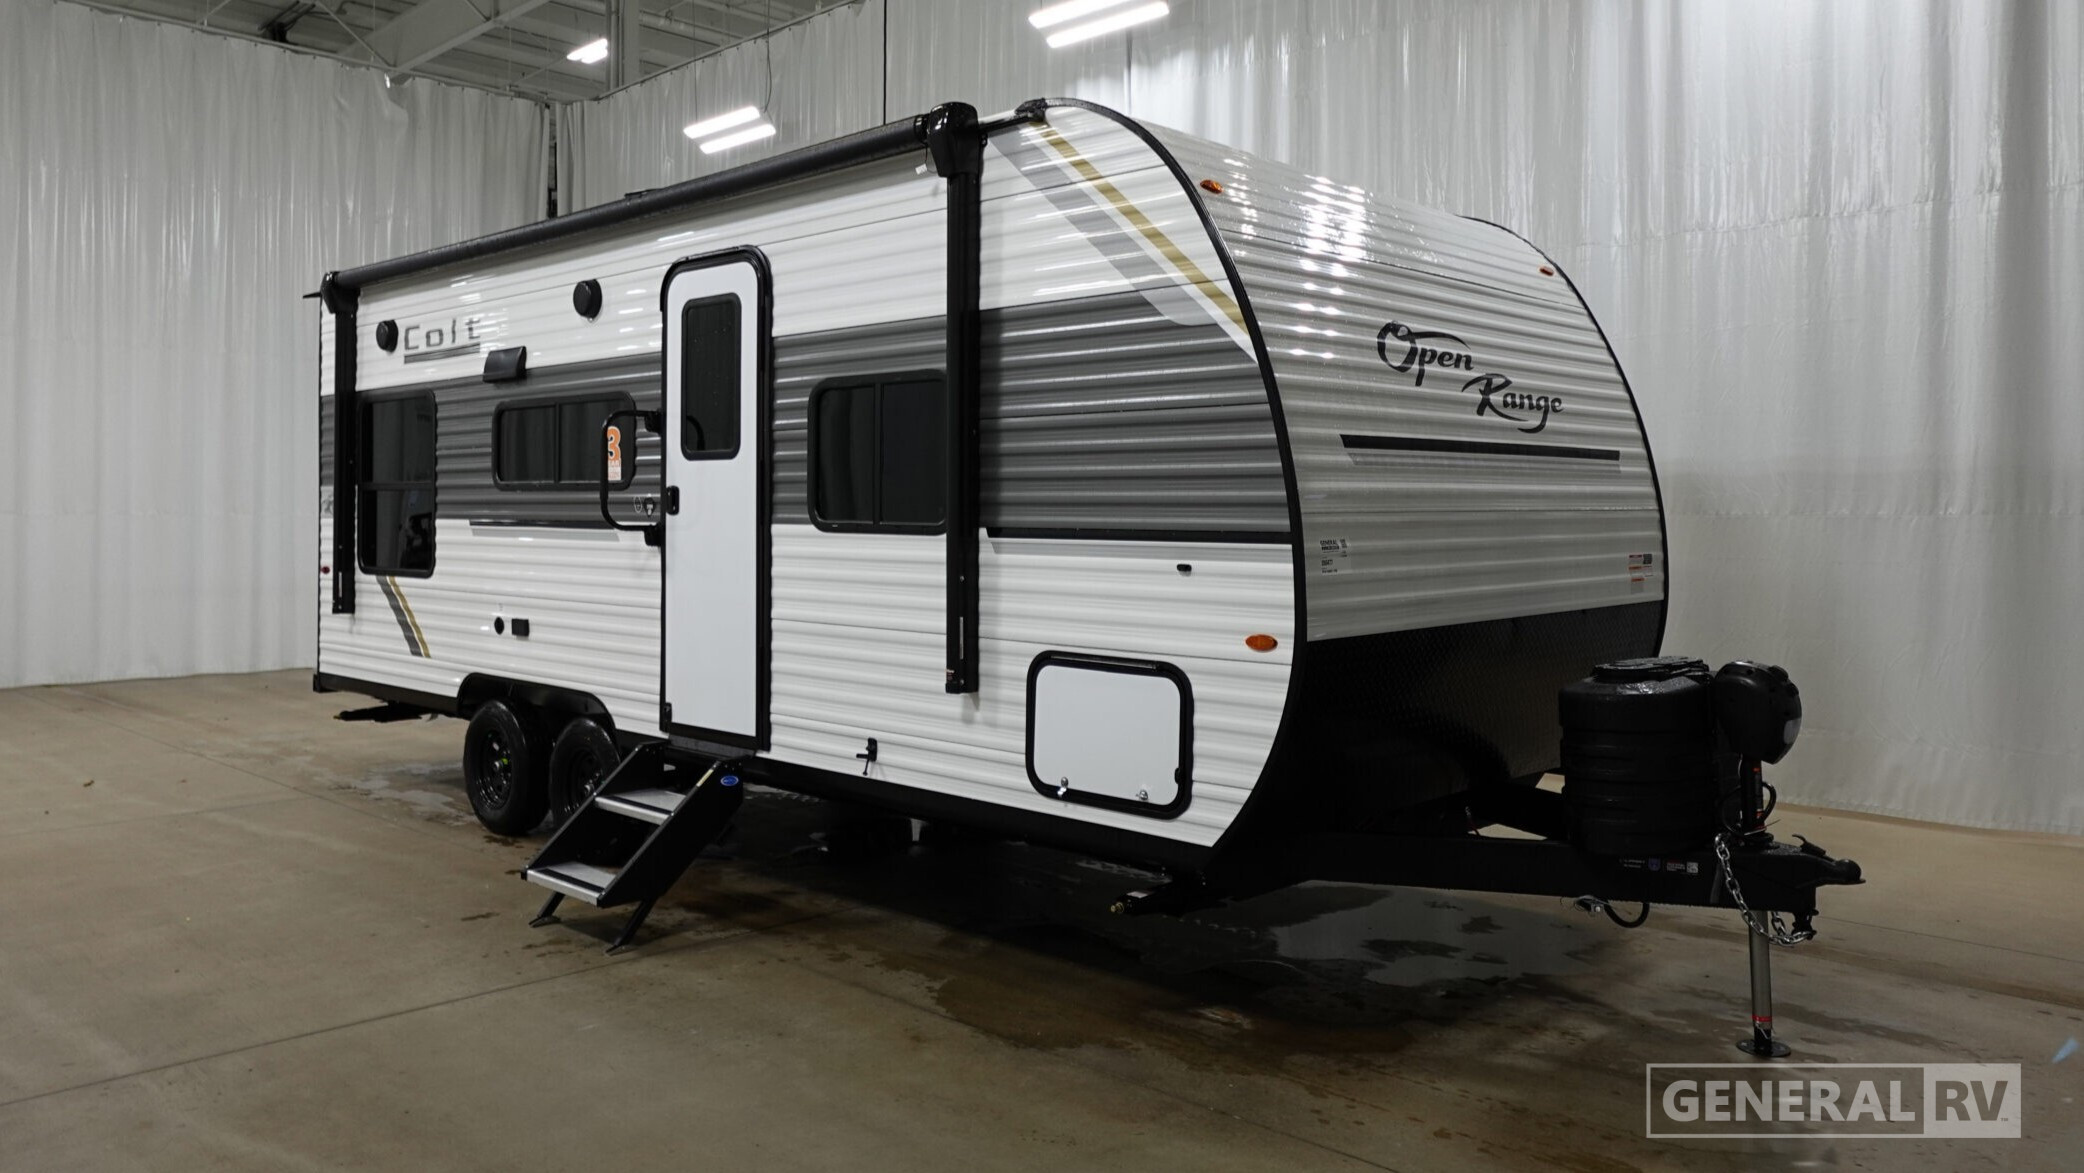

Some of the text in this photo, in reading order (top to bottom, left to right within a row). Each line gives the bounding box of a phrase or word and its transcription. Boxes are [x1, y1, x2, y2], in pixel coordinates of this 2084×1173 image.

[404, 317, 480, 350] Colt
[1377, 320, 1474, 386] Open
[1462, 373, 1564, 434] Range
[607, 426, 621, 461] 3
